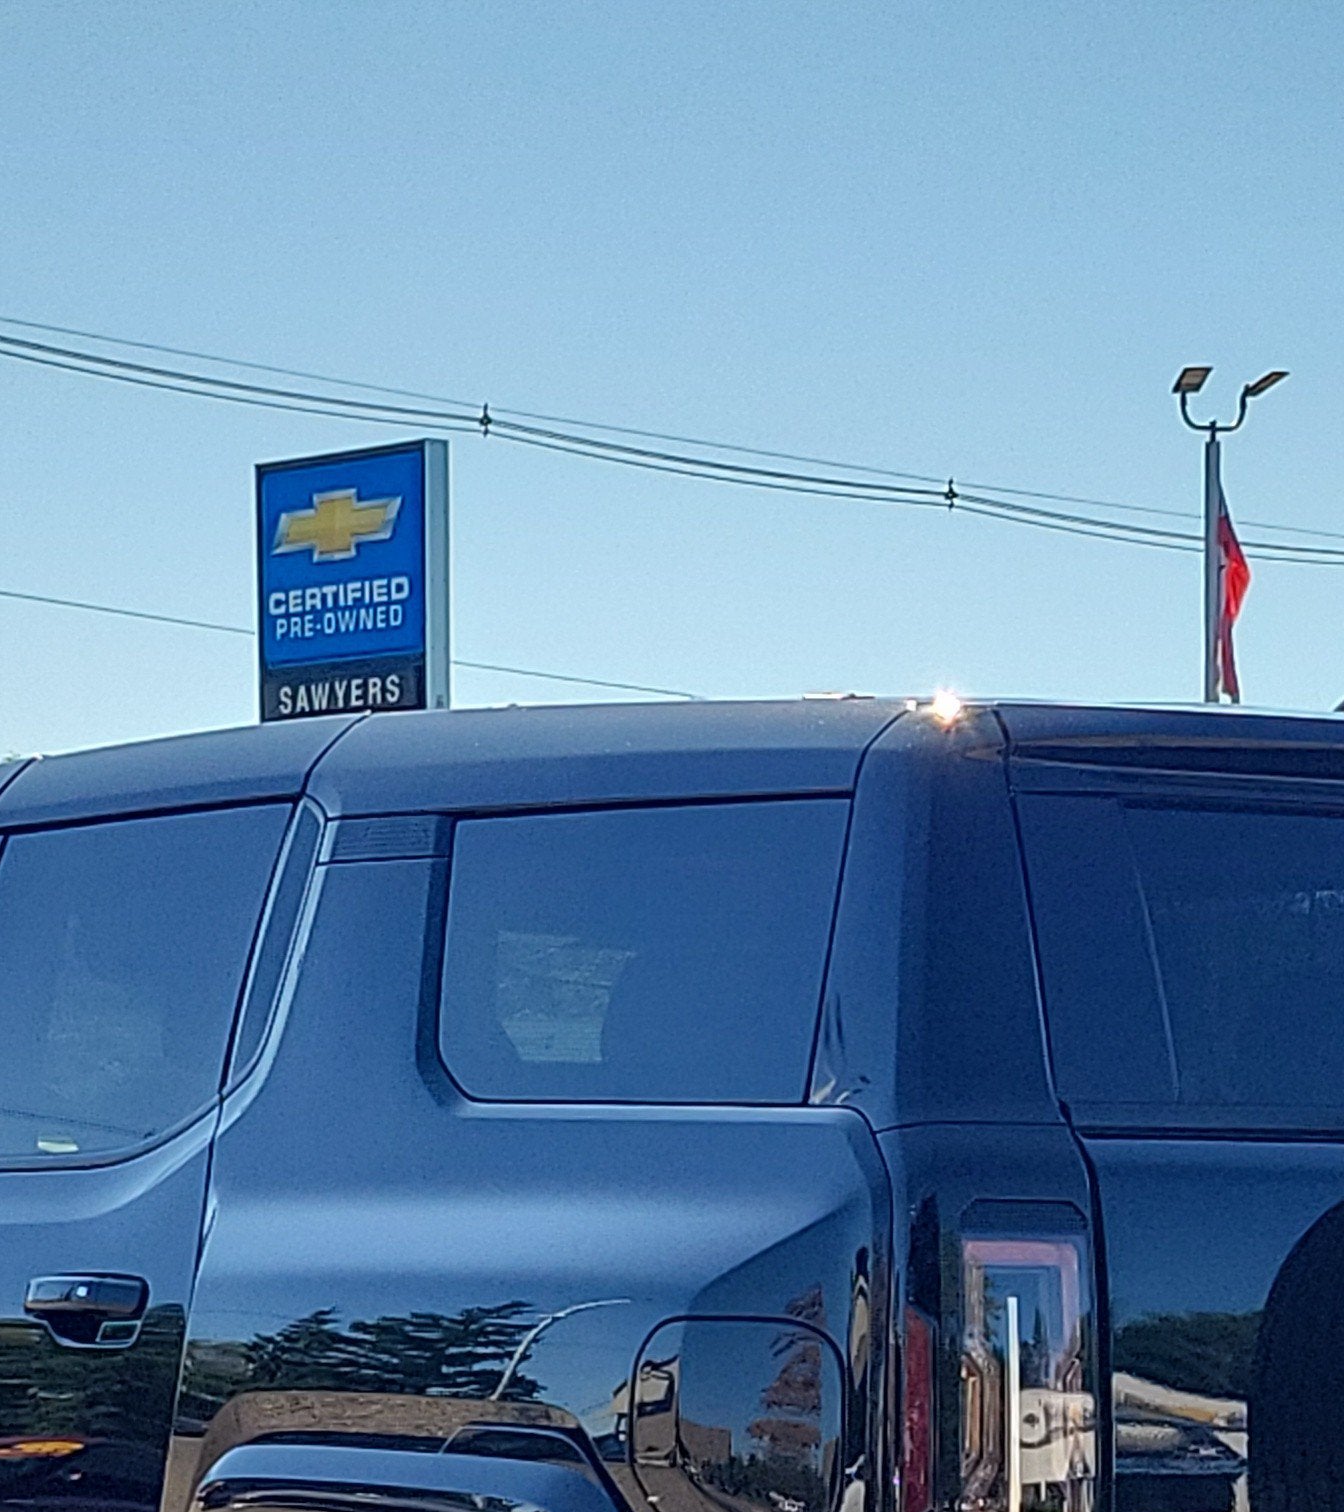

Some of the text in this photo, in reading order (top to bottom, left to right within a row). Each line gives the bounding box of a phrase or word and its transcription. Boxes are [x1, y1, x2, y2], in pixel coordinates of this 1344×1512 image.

[268, 576, 410, 616] CERTIFIED
[276, 604, 403, 640] PRE-OWNED
[279, 675, 401, 714] SAWYERS
